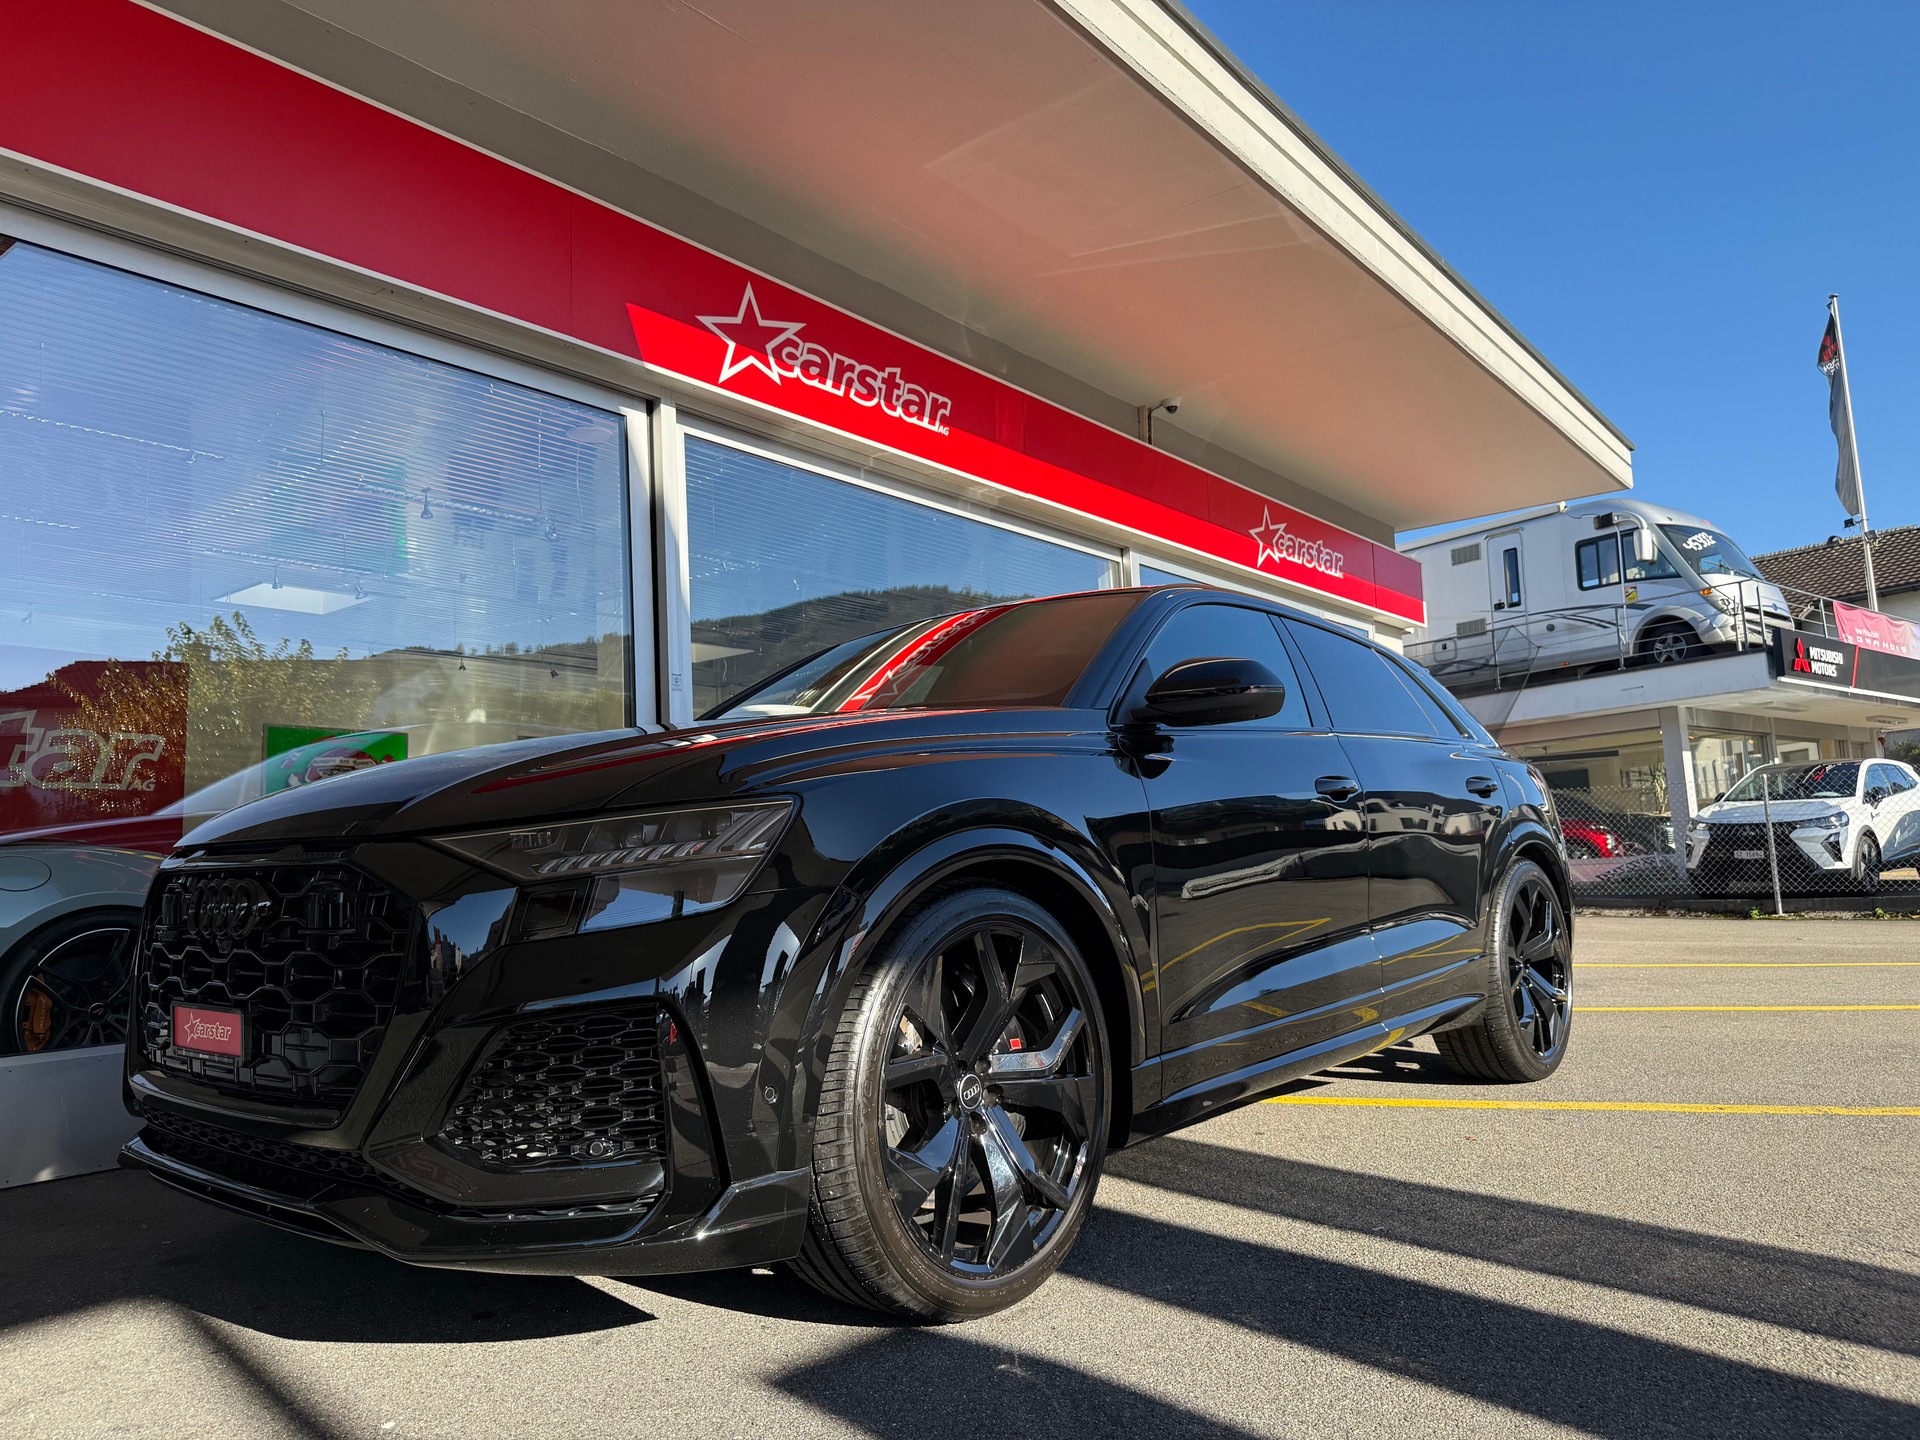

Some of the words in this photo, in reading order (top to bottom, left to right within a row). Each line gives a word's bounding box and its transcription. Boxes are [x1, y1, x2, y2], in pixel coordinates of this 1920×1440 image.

[770, 333, 952, 432] carstar
[937, 424, 949, 436] AG
[1273, 532, 1344, 576] carstar
[1857, 636, 1907, 654] GRANDIS
[1809, 646, 1844, 665] MITSUBISHI
[1811, 661, 1838, 678] MOTORS
[129, 779, 157, 791] AG
[194, 1021, 232, 1041] carstar
